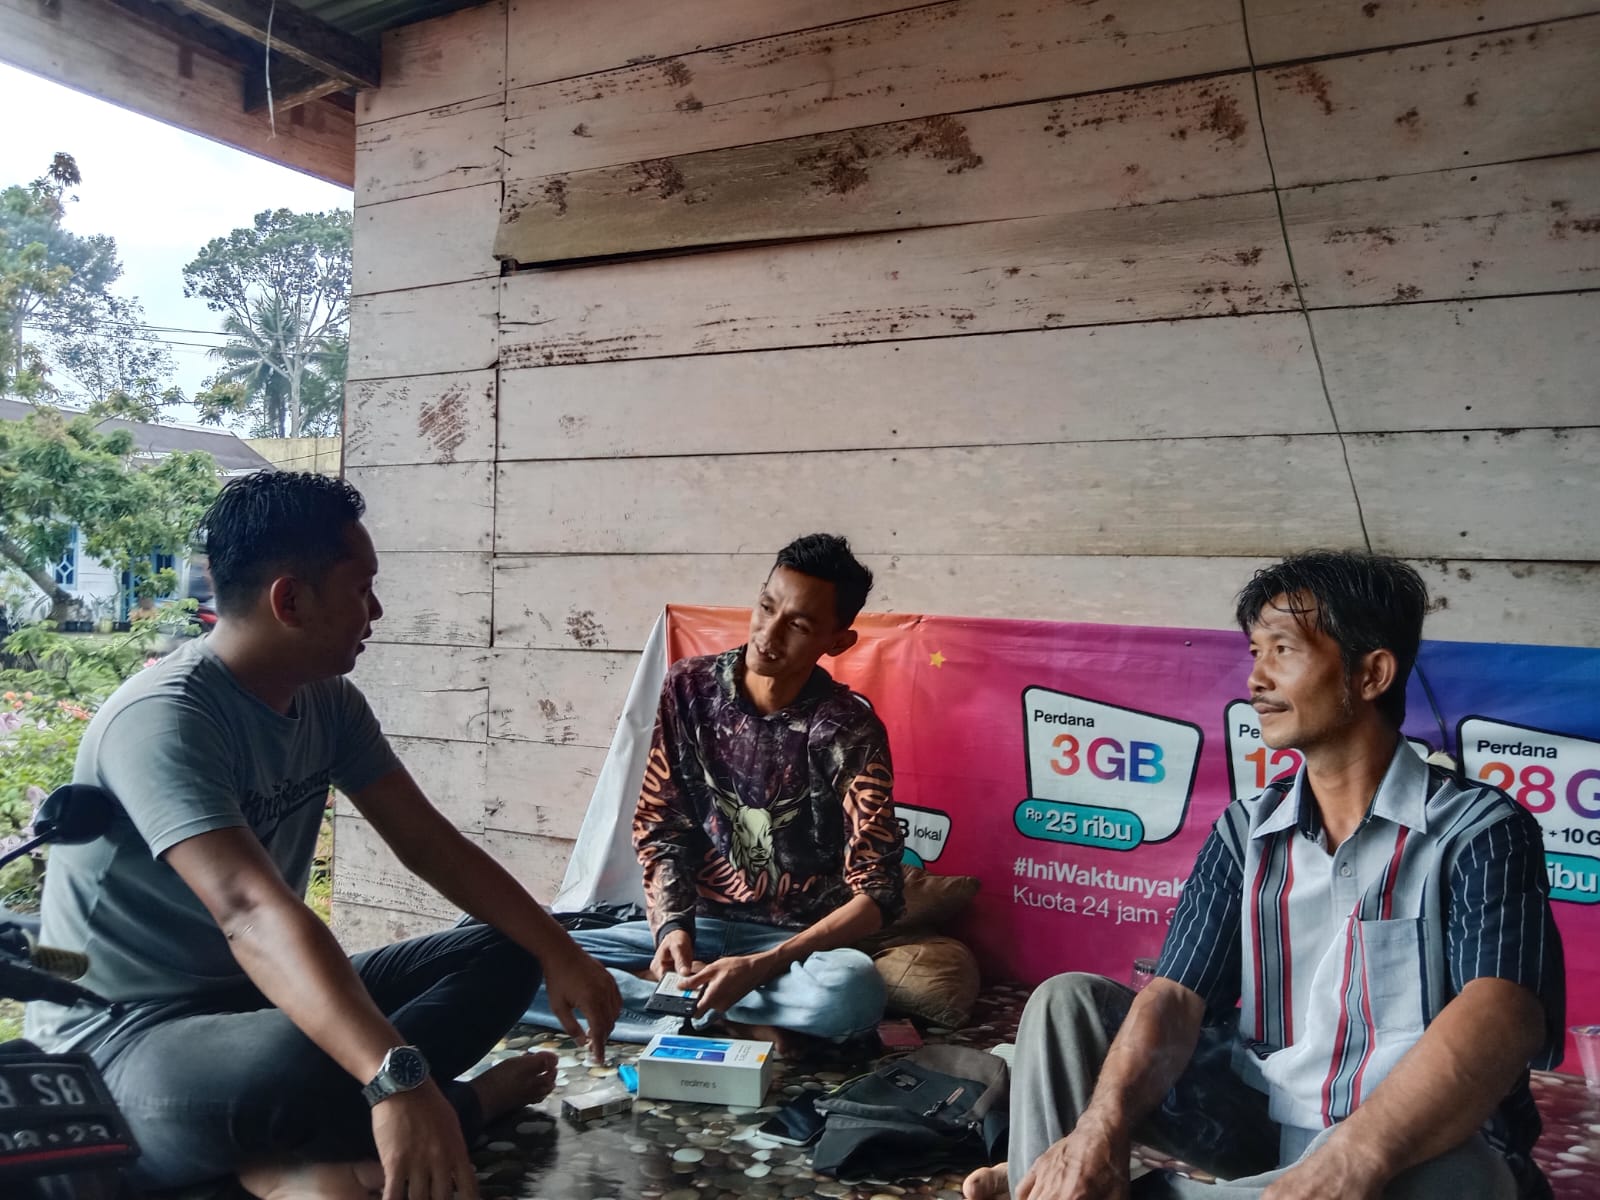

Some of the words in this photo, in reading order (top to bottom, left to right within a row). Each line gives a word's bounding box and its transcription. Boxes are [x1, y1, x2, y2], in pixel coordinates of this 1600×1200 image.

[1034, 709, 1095, 728] Perdana
[1477, 739, 1558, 759] Perdana
[914, 825, 943, 842] lokal
[1025, 808, 1043, 822] Rp
[1045, 810, 1078, 834] 25
[1082, 816, 1132, 842] ribu
[1547, 863, 1599, 894] ibu
[1013, 885, 1076, 914] Kuota
[1082, 896, 1110, 918] 24
[1115, 900, 1159, 925] jam
